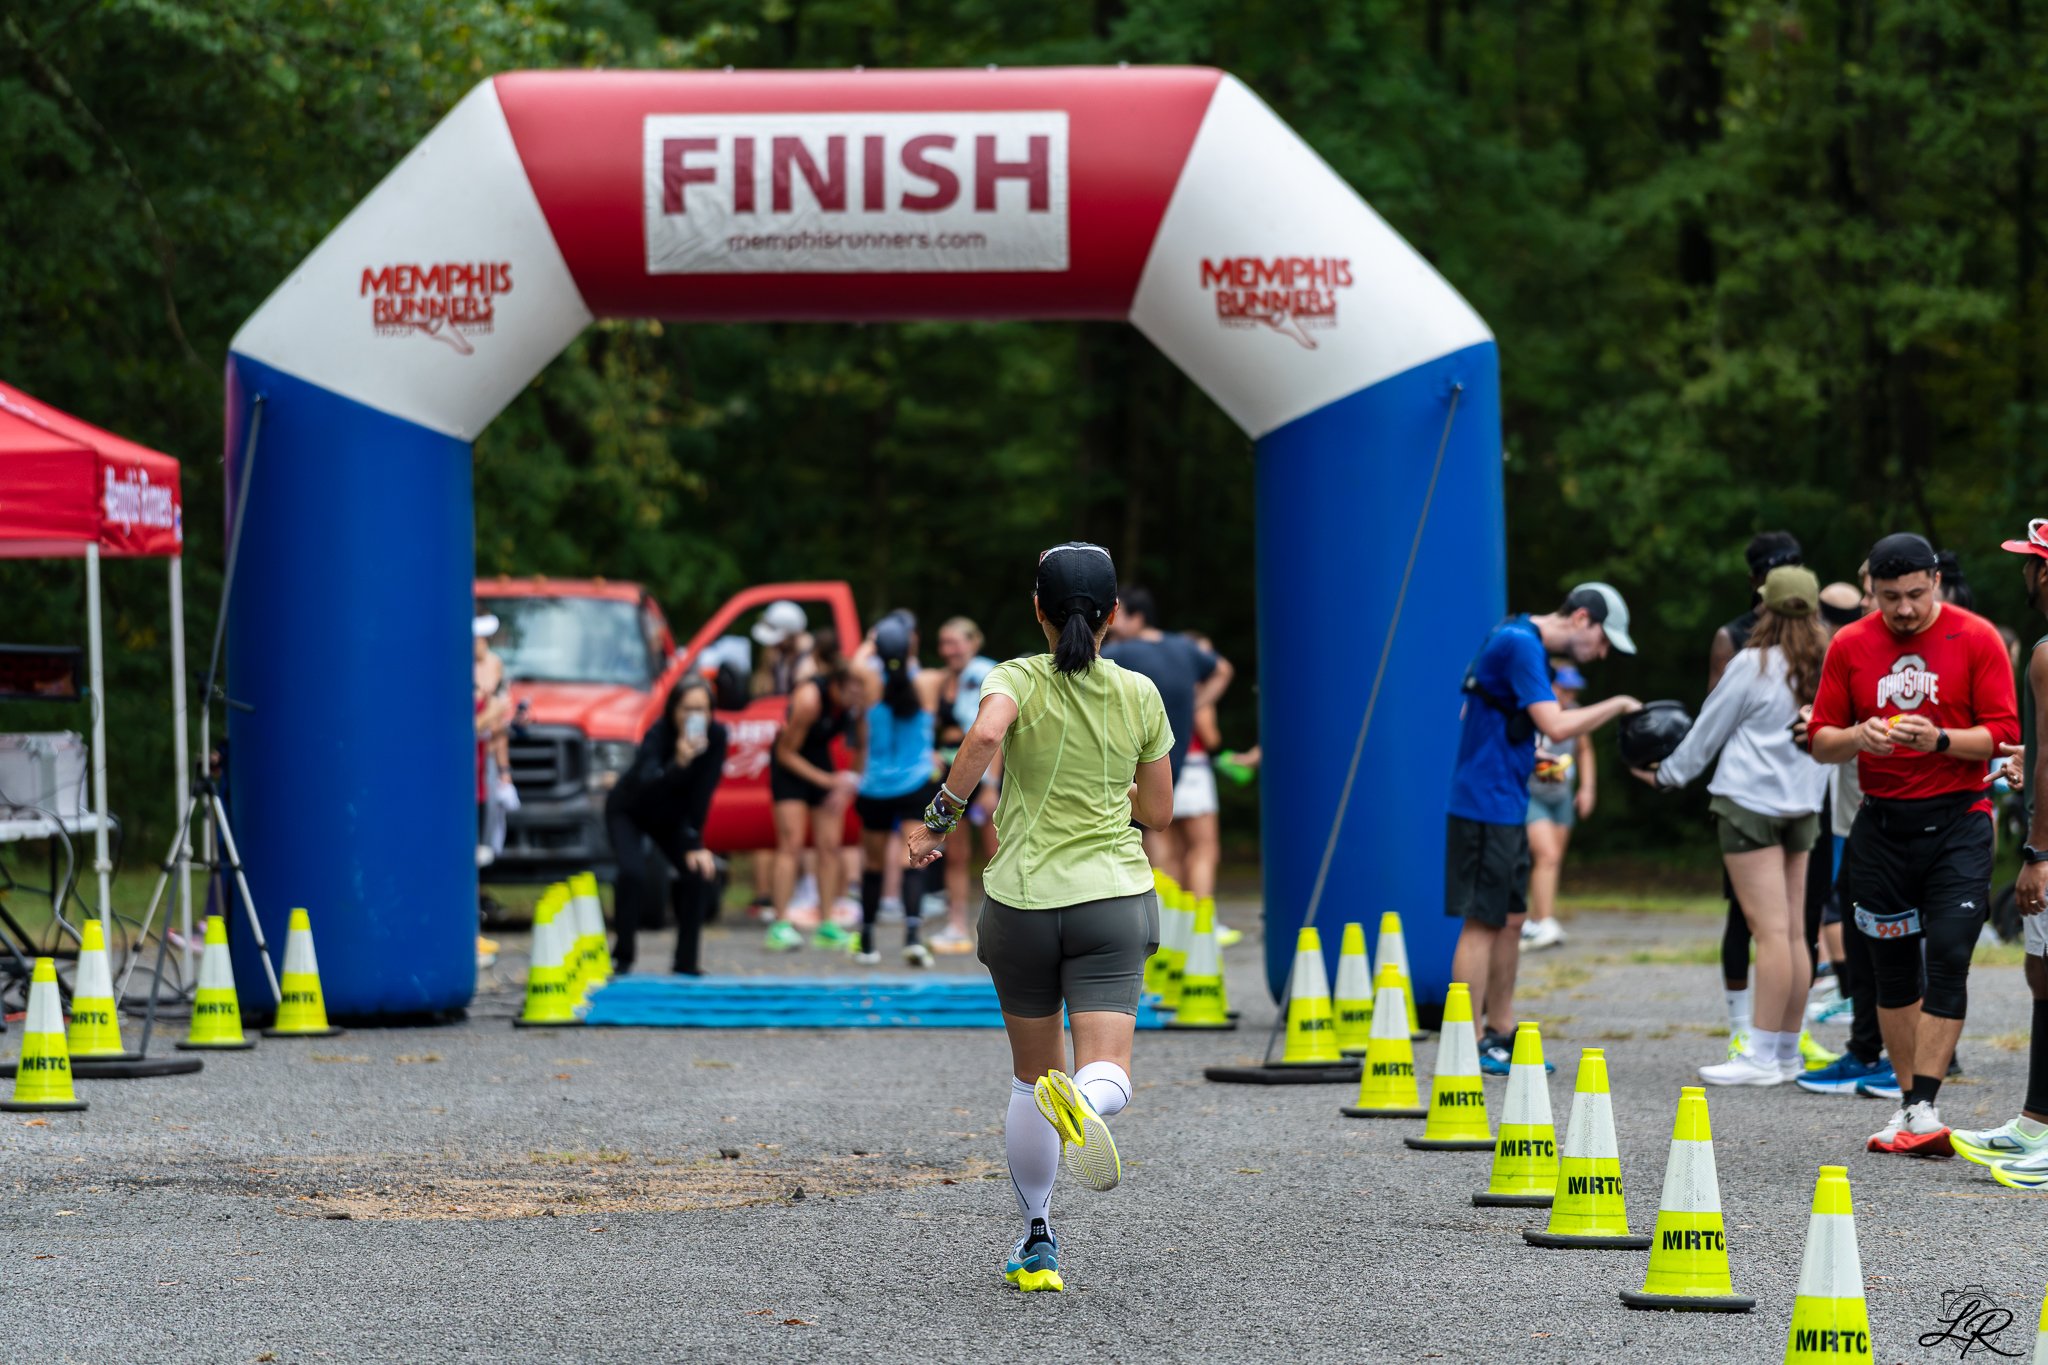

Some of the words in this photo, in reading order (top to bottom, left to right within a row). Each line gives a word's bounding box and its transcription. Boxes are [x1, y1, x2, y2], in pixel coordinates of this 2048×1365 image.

[662, 134, 1051, 216] FINISH
[729, 230, 987, 252] memphisrunners.com
[361, 261, 513, 297] MEMPHIS
[1201, 256, 1353, 290] MEMPHIS
[373, 296, 494, 327] RUNNERS
[1216, 289, 1337, 318] RUNNERS
[1876, 918, 1909, 938] 961
[197, 1002, 236, 1015] MRTC
[22, 1056, 66, 1072] MRTC
[1501, 1139, 1554, 1157] MRTC
[1568, 1176, 1622, 1195] MRTC
[1662, 1230, 1724, 1251] MRTC
[1796, 1328, 1867, 1355] MRTC
